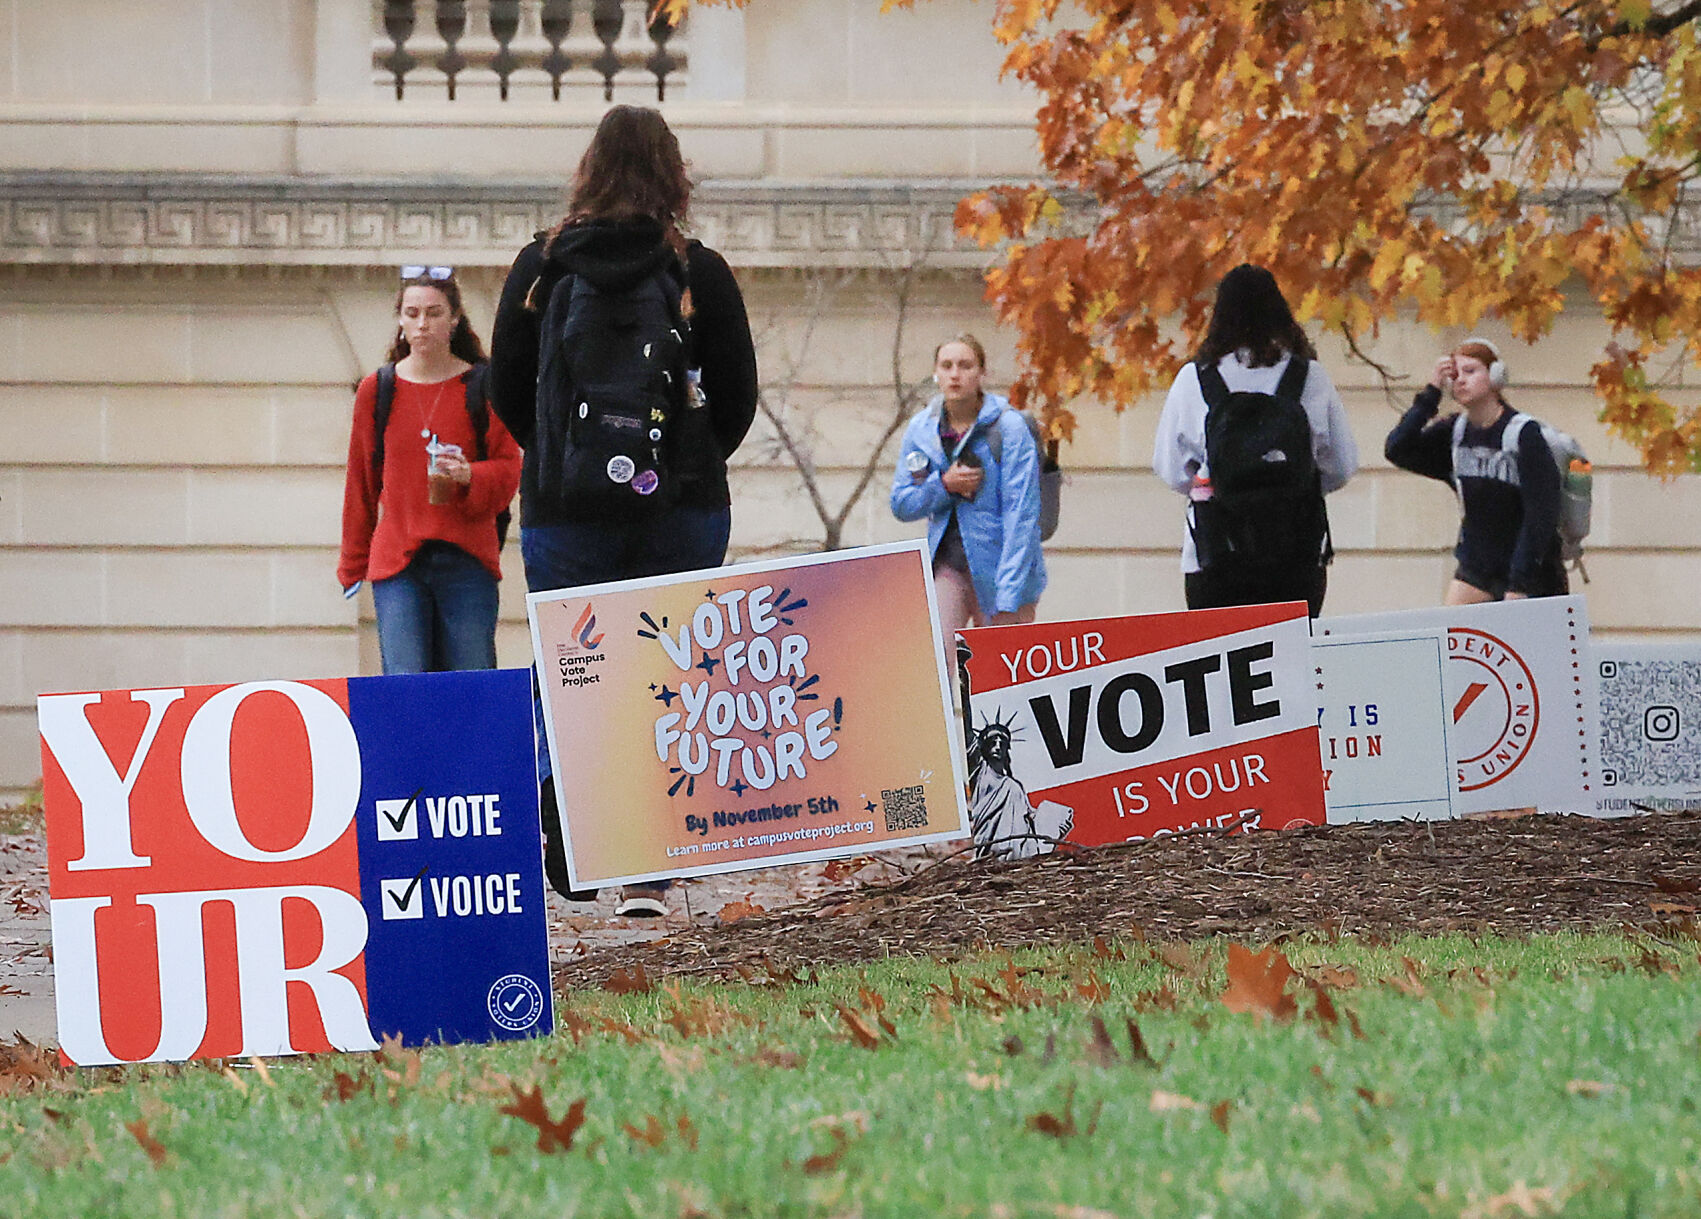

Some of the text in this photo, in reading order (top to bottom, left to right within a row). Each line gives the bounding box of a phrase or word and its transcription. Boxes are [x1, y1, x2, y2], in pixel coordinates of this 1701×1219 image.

[657, 585, 778, 671] VOTE
[559, 653, 605, 666] Campus
[560, 666, 586, 676] Vote
[724, 634, 809, 686] FOR
[1001, 632, 1107, 683] YOUR
[562, 674, 600, 688] Project
[680, 681, 799, 736] YOUR
[1028, 641, 1281, 769] VOTE
[1349, 704, 1378, 727] IS
[655, 697, 843, 790] FUTURE!
[1329, 735, 1382, 759] ION
[1481, 704, 1529, 776] UNION
[1112, 754, 1270, 818] IS YOUR
[425, 794, 502, 838] VOTE
[685, 796, 839, 836] By November 5th
[666, 820, 874, 857] Learn more at campusvoteproject.org
[430, 873, 523, 917] VOICE
